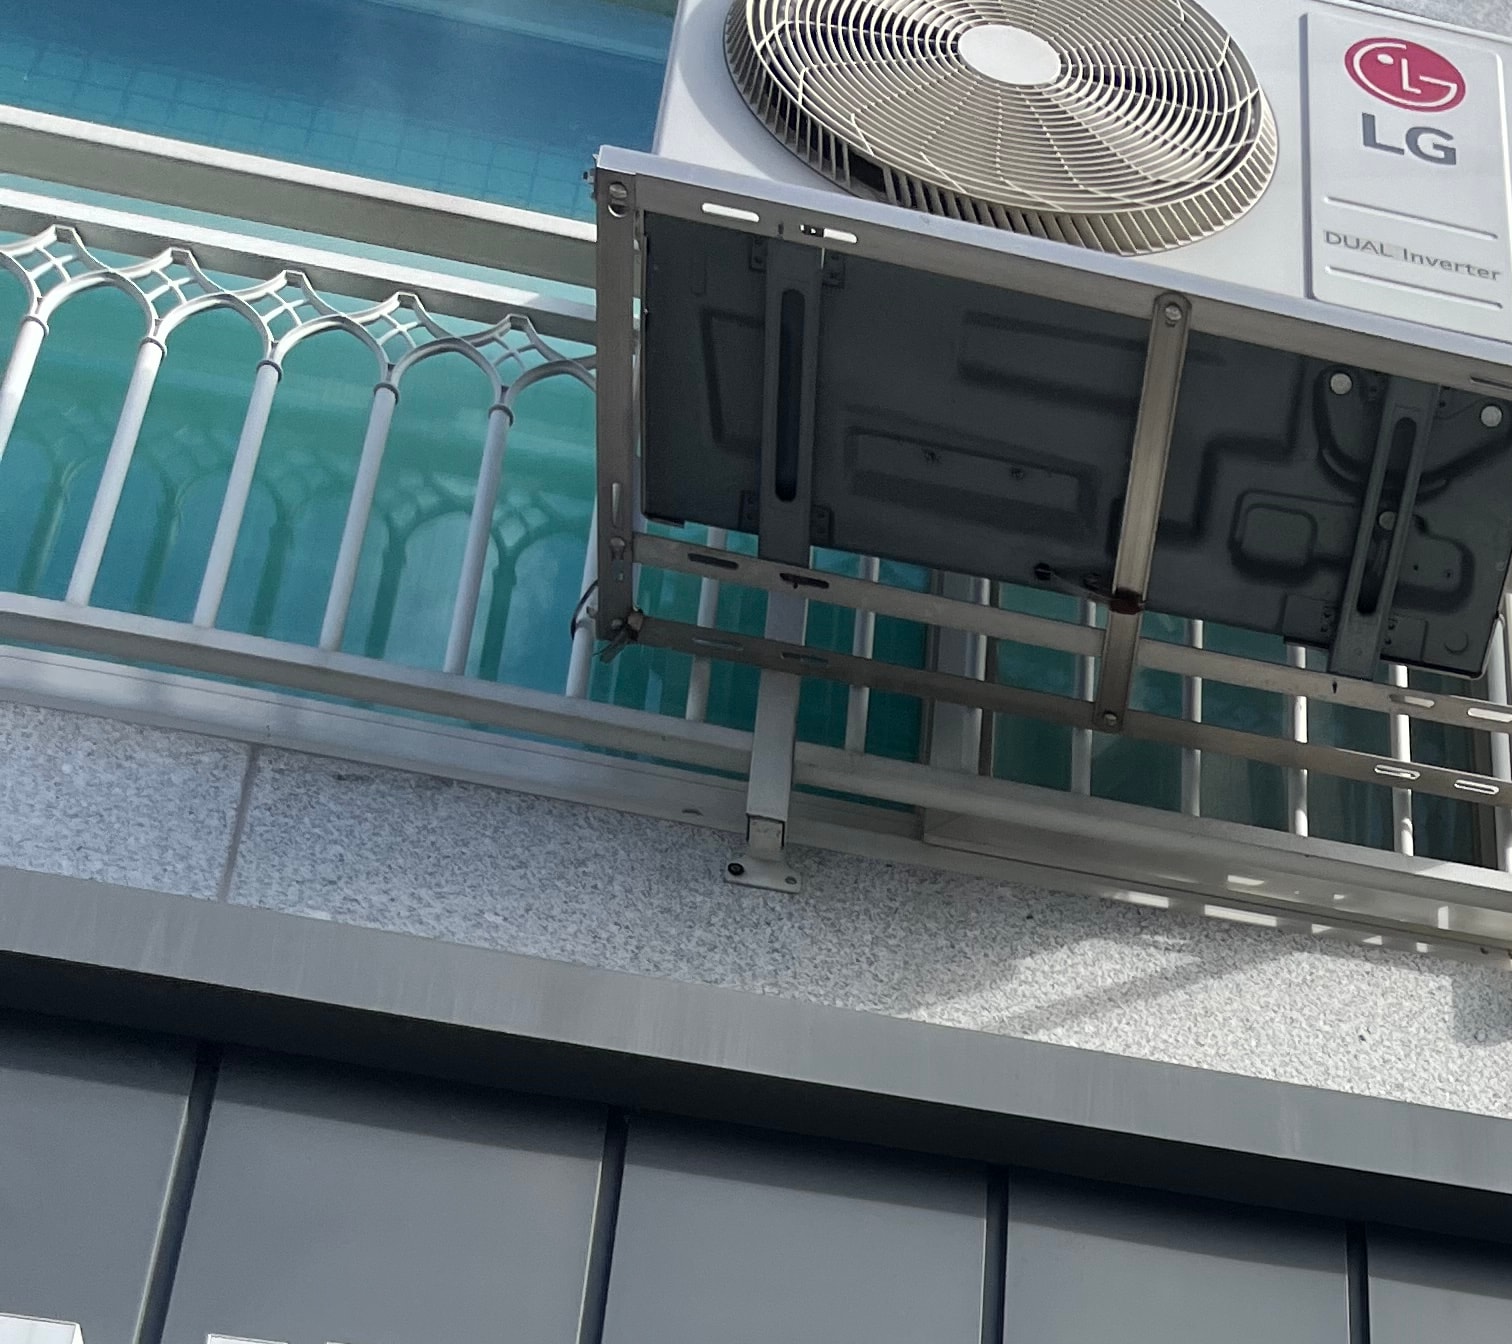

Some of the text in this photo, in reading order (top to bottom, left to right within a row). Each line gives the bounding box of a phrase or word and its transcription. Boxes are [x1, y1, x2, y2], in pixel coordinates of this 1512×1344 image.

[1361, 112, 1457, 166] LG
[1322, 229, 1503, 282] DUAL Inverter
